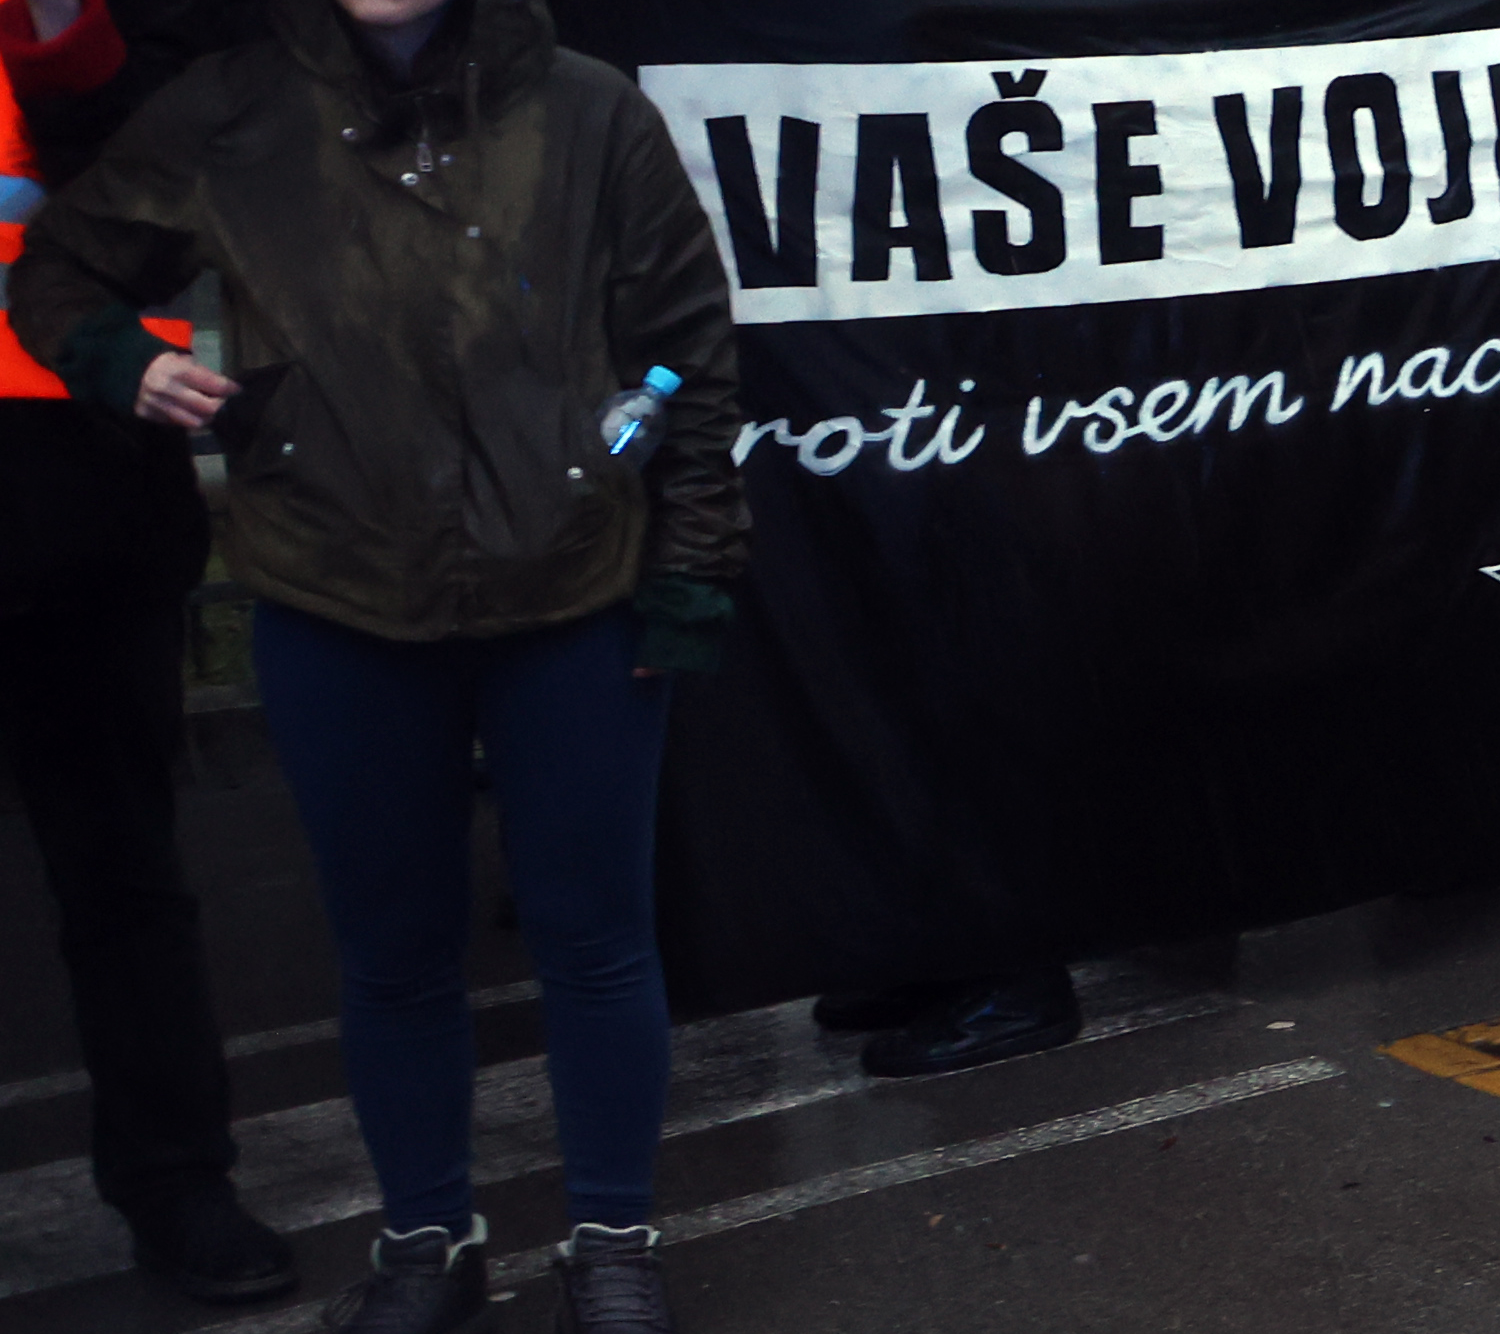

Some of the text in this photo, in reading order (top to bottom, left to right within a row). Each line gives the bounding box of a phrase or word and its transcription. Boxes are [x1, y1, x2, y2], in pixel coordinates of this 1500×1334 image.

[704, 67, 1165, 289] VAŠE
[731, 377, 985, 477] roti
[1021, 367, 1303, 455] vsem
